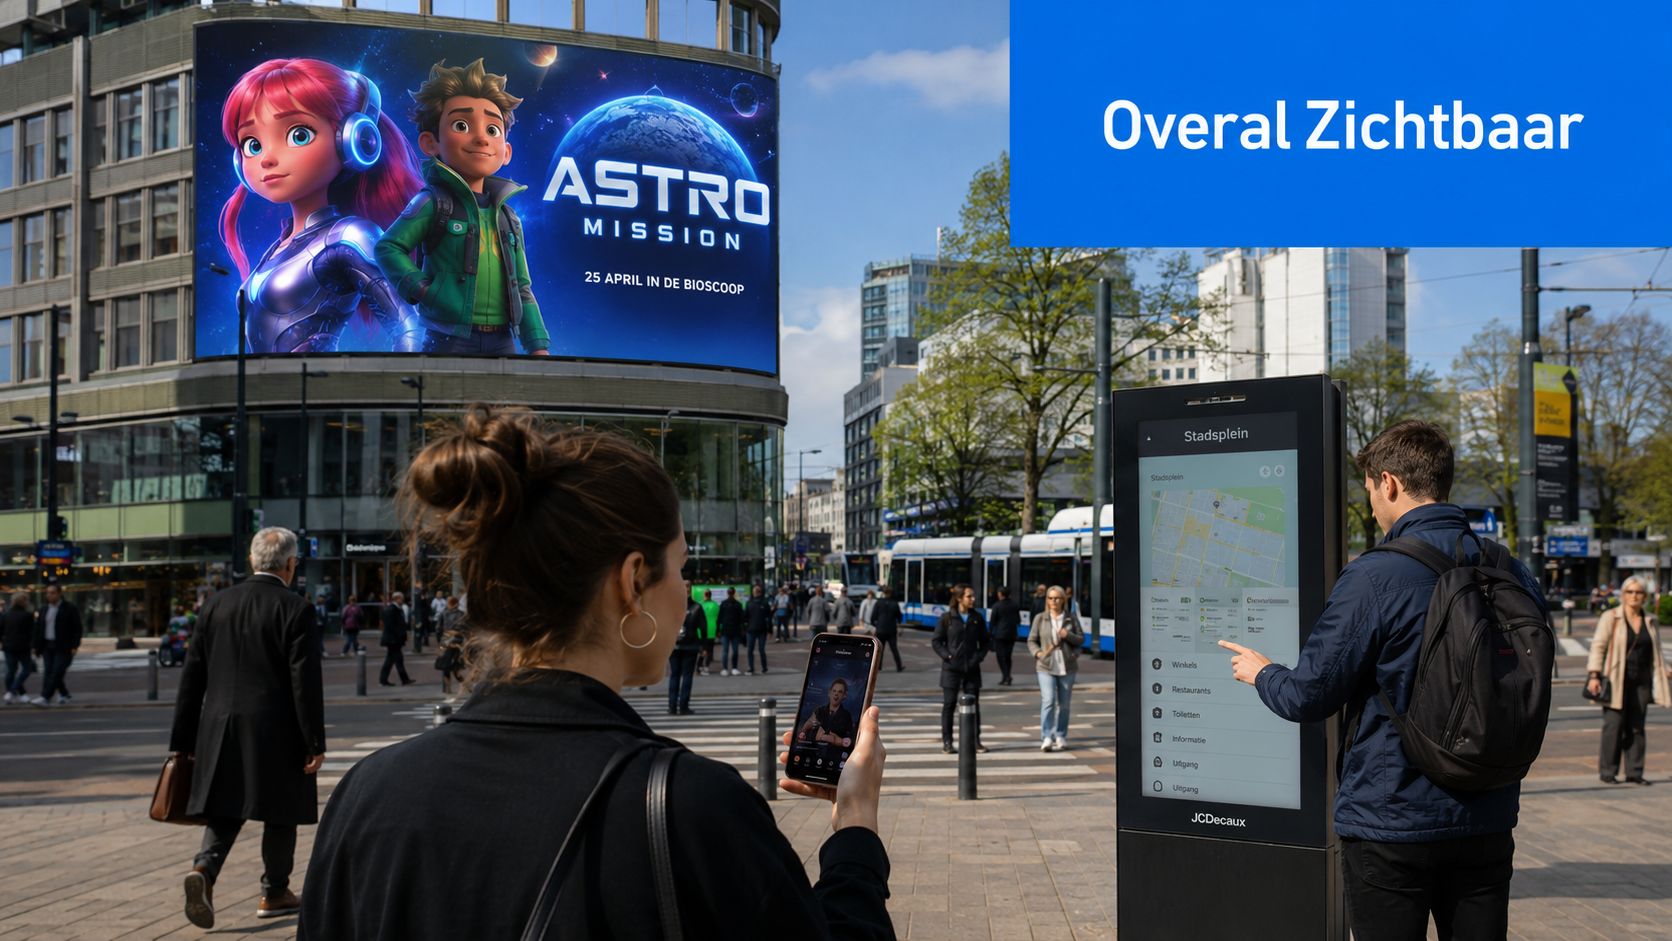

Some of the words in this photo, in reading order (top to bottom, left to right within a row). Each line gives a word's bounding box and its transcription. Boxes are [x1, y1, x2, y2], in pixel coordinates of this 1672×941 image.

[542, 156, 771, 226] ASTRO
[583, 217, 741, 251] MISSION
[584, 271, 601, 283] 25
[604, 272, 643, 287] APRIL
[646, 275, 660, 288] IN
[663, 277, 680, 290] DE
[683, 278, 745, 295] BIOSCOOP
[1184, 427, 1249, 442] Stadsplein
[1150, 473, 1184, 482] Stadsplein
[1171, 661, 1198, 669] Winkels
[1171, 685, 1211, 695] Restaurants
[1172, 710, 1201, 719] Toiletten
[1172, 735, 1207, 744] Informatie
[1191, 812, 1246, 828] JCDecaux
